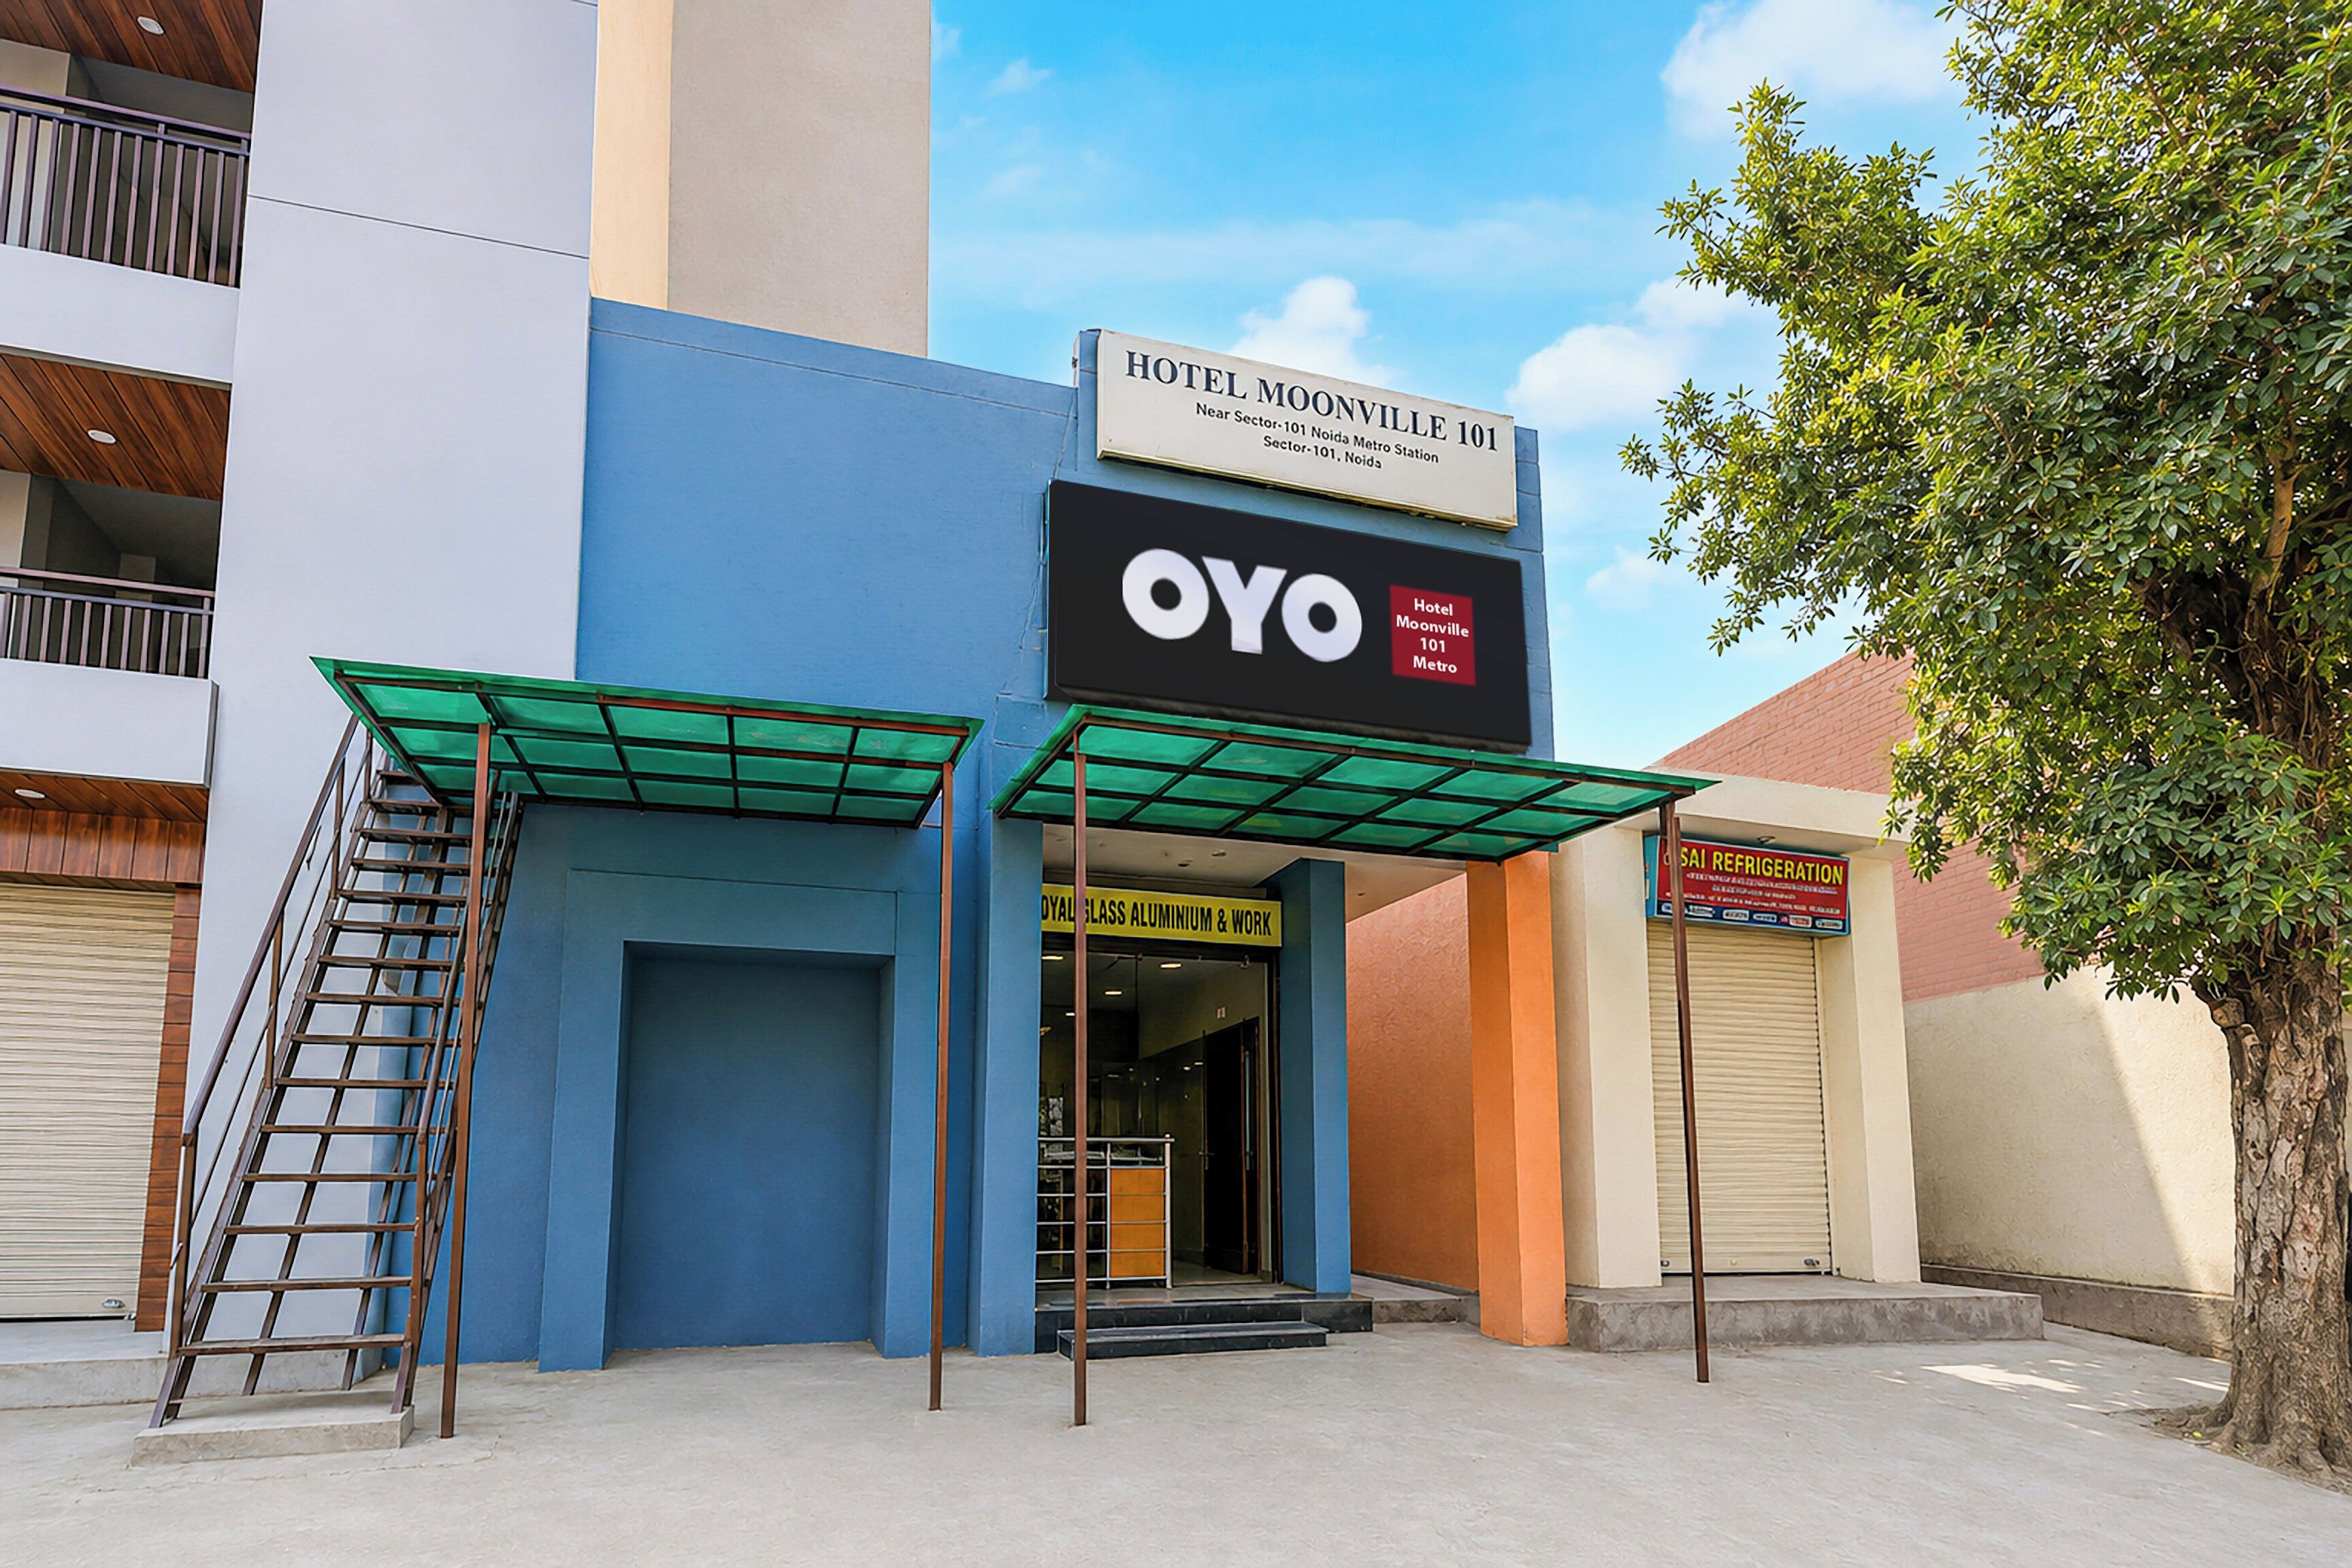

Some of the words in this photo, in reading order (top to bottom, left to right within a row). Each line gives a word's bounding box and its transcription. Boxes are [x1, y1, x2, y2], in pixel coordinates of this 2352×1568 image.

[1126, 350, 1247, 399] HOTEL
[1256, 377, 1447, 440] MOONVILLE
[1458, 421, 1497, 451] 101
[1196, 402, 1230, 420] Near
[1234, 410, 1305, 436] Sector-101
[1311, 426, 1350, 444] Noida
[1354, 435, 1391, 454] Metro
[1394, 443, 1439, 463] Station
[1345, 451, 1382, 469] Noida
[1122, 548, 1362, 663] OYO
[1414, 598, 1453, 616] Hotel
[1396, 614, 1469, 638] Moonville
[1420, 637, 1446, 653] 101
[1413, 655, 1457, 674] Metro
[1680, 846, 1705, 869] SAI
[1712, 851, 1844, 885] REFRIGERATION
[1041, 894, 1075, 922] OYAL
[1130, 901, 1212, 932] ALUMINIUM
[1217, 908, 1227, 933] &
[1232, 909, 1271, 936] WORK
